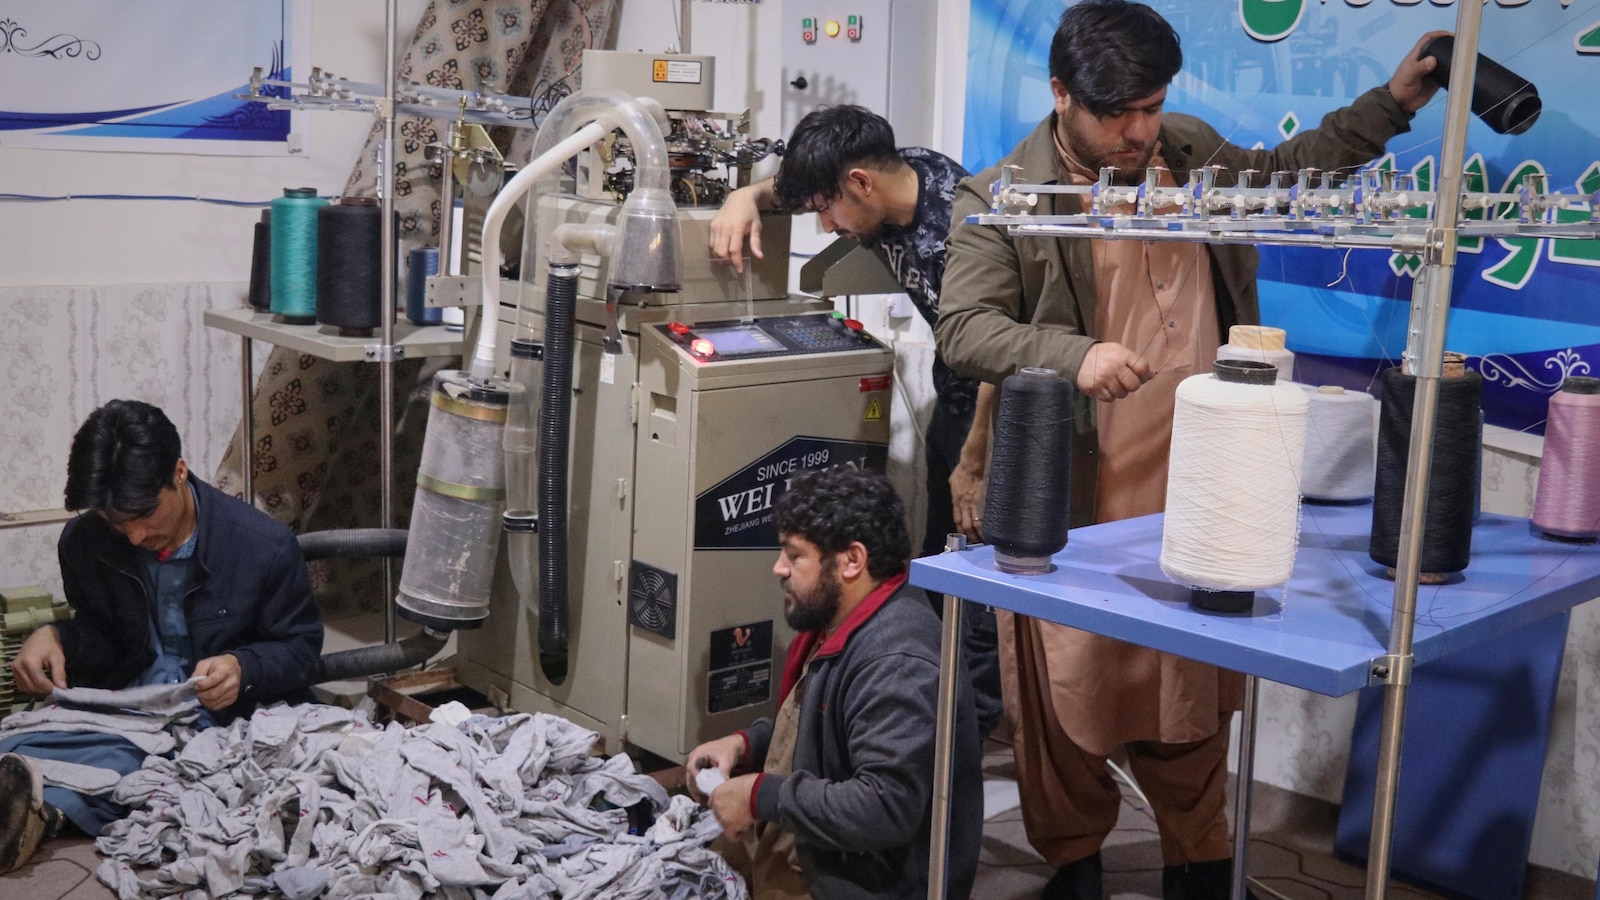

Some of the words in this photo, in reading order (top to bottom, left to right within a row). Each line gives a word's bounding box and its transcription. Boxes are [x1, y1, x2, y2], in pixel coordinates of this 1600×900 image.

[757, 457, 798, 482] SINCE
[801, 449, 830, 469] 1999
[718, 483, 775, 522] WEI
[725, 518, 759, 535] ZHEJIANG
